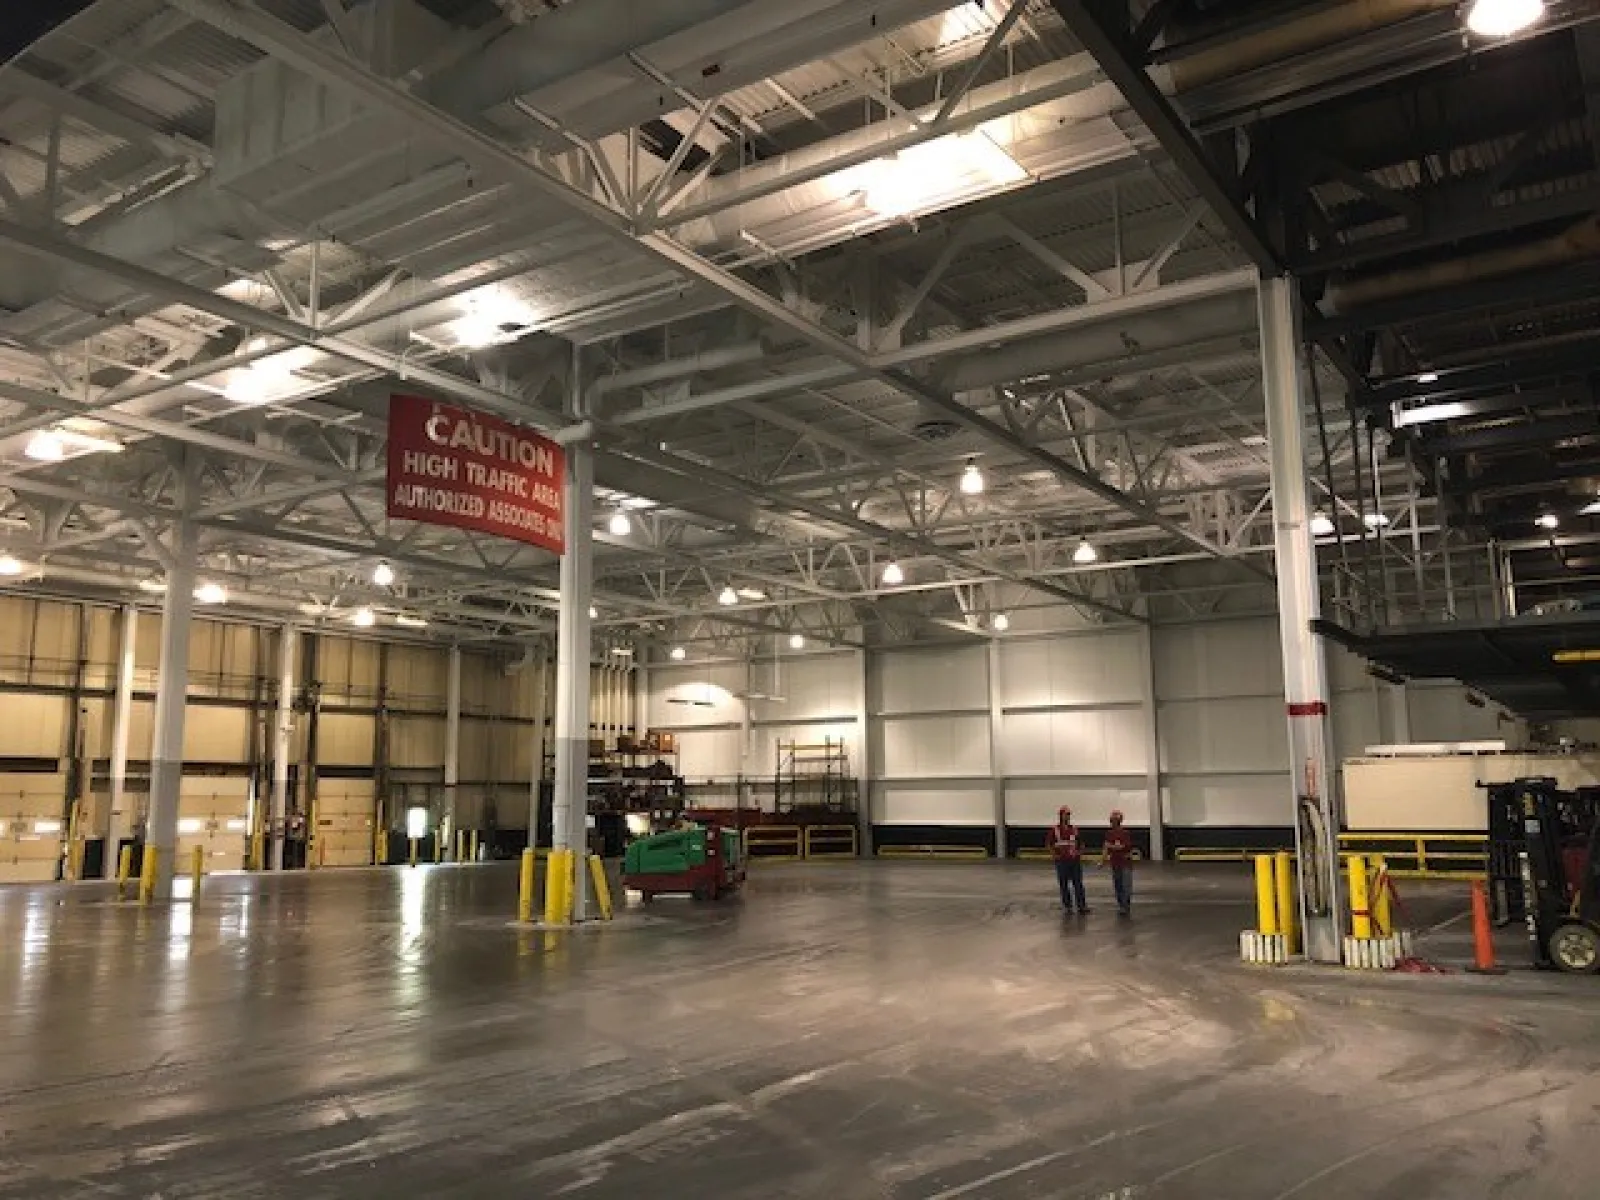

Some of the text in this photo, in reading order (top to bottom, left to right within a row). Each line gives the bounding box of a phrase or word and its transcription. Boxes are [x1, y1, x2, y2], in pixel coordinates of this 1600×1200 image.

[425, 414, 554, 478] CAUTION
[404, 450, 458, 480] HIGH
[465, 461, 527, 498] TRAFFIC
[395, 484, 485, 518] AUTHORIZED
